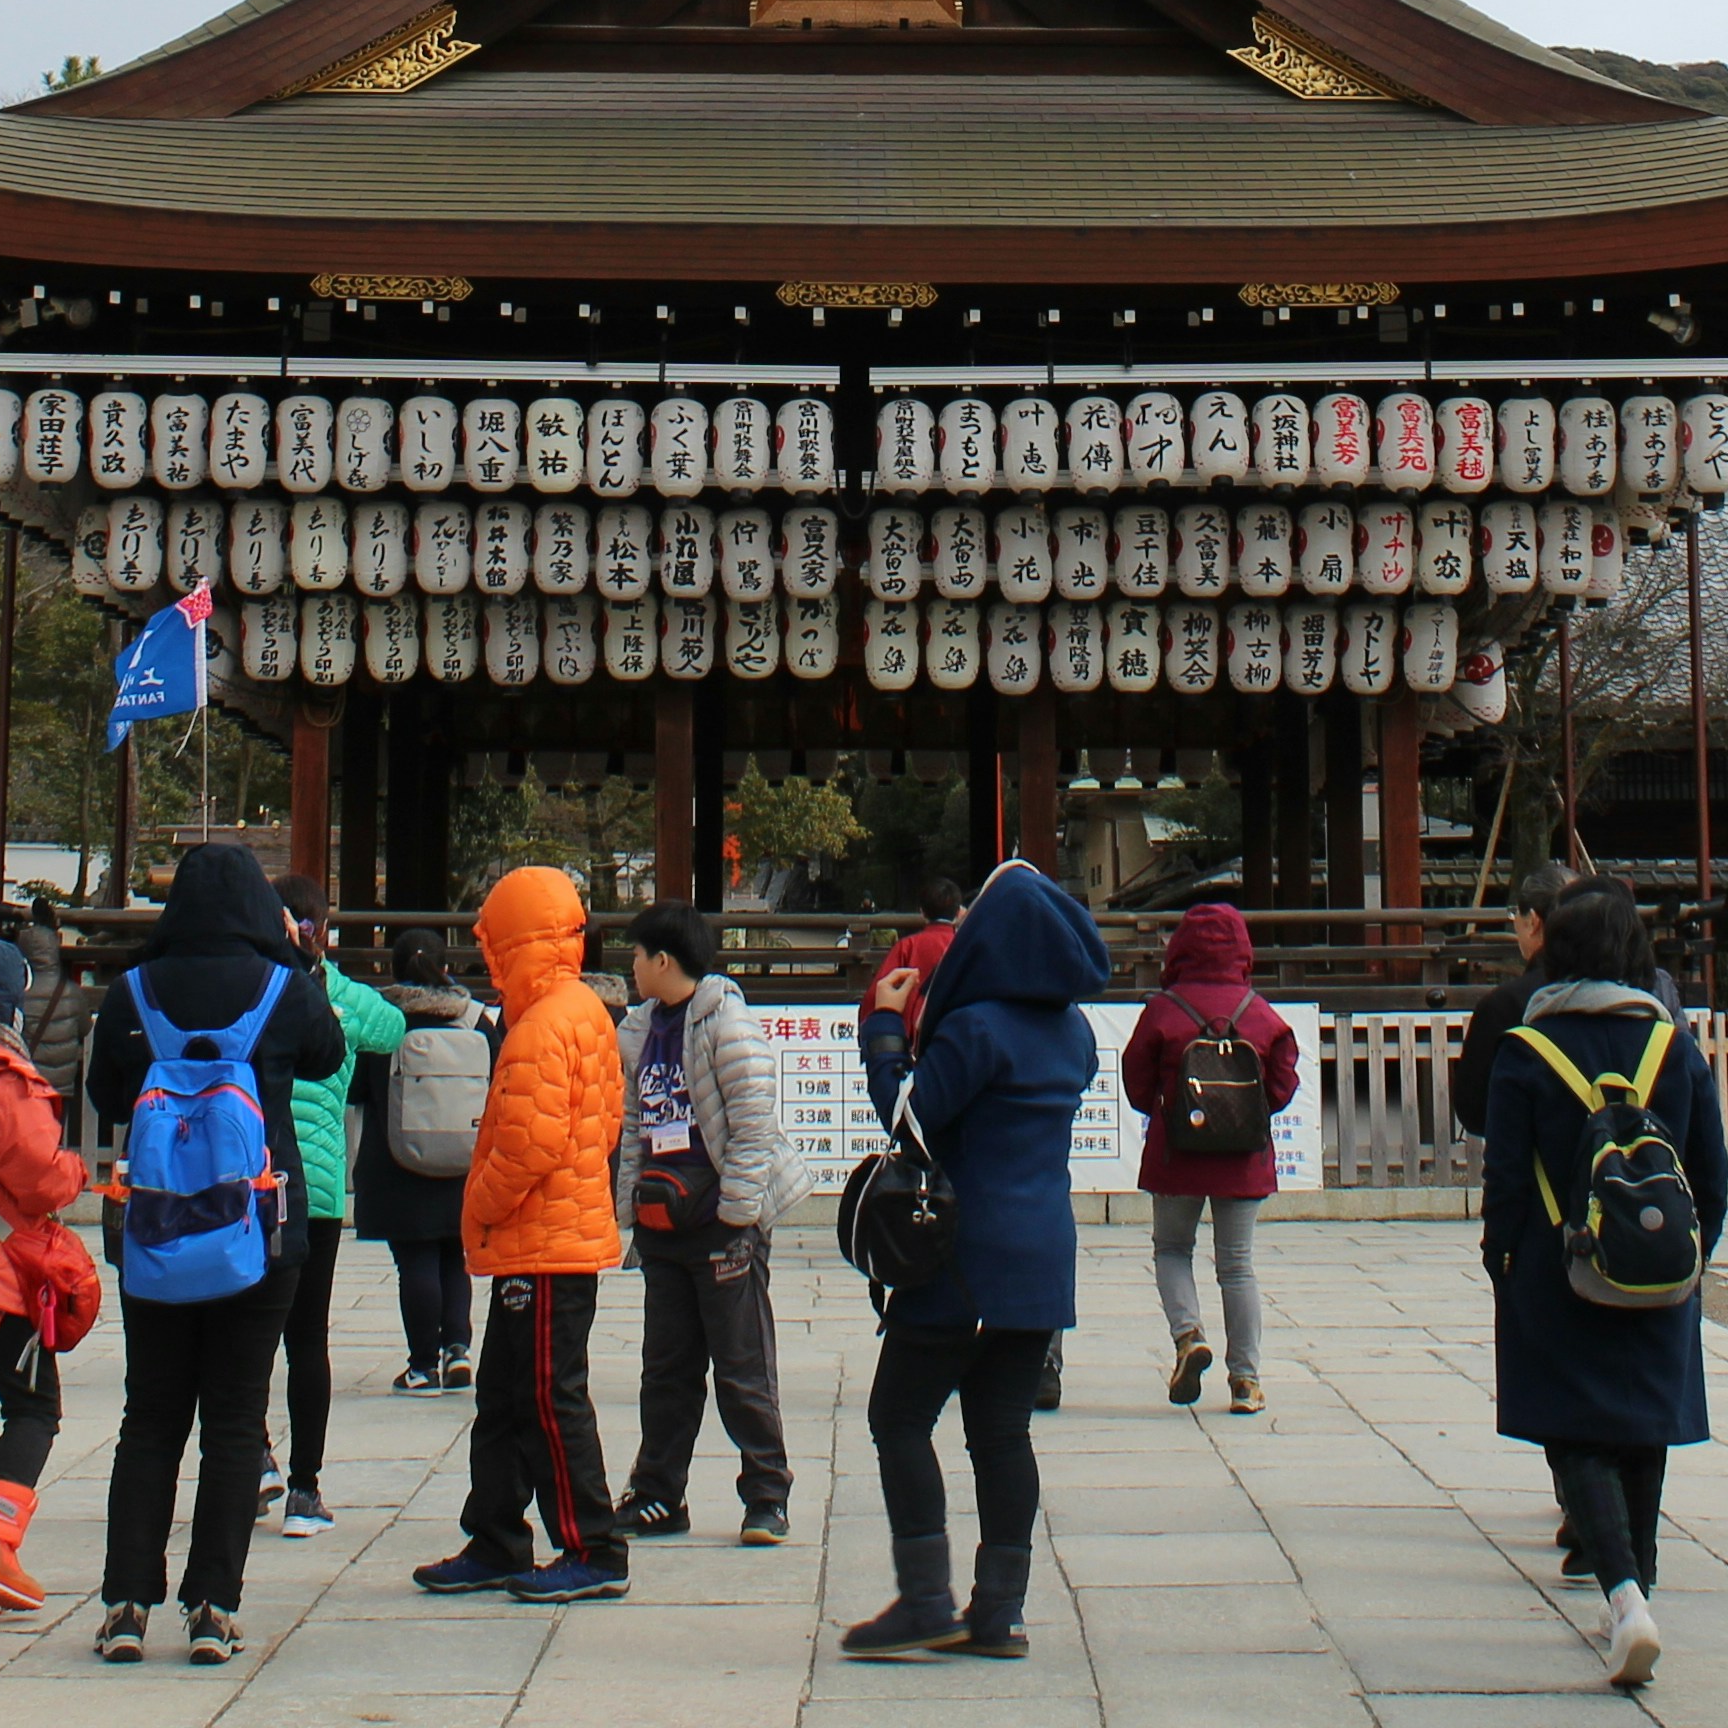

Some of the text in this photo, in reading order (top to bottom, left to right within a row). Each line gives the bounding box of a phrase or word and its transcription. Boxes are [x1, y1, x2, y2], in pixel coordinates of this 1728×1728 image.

[36, 393, 67, 475] 家田荘子
[101, 399, 127, 475] 貴久政
[221, 400, 250, 479] たまや
[289, 403, 317, 484] 富美代
[414, 409, 444, 481] いし初
[476, 410, 510, 484] 堀八重
[666, 405, 696, 480] ふく葉
[797, 400, 821, 481] 宮川町歌舞会
[959, 401, 982, 479] まつもと
[1018, 401, 1048, 476] 叶恵
[1207, 395, 1237, 453] えん
[1271, 397, 1301, 472] 八坂神社
[1331, 396, 1361, 466] 富美芳
[1395, 399, 1428, 472] 富美苑
[1522, 409, 1544, 485] よし富美
[1582, 408, 1610, 490] 桂あす香
[1641, 406, 1668, 489] 桂あす香
[798, 515, 830, 588] 富久家
[1011, 517, 1041, 584] 小花
[1068, 517, 1096, 588] 市光
[1132, 513, 1160, 587] 豆千佳
[1194, 511, 1221, 587] 久富美
[1318, 507, 1345, 584] 小扇
[1432, 510, 1464, 580] 叶家
[1180, 611, 1214, 686] 柳笑会
[1359, 611, 1386, 687] カトレヤ
[796, 1081, 831, 1095] 19歳
[797, 1056, 832, 1070] 女性
[794, 1109, 832, 1123] 33歳
[797, 1137, 832, 1153] 37歳
